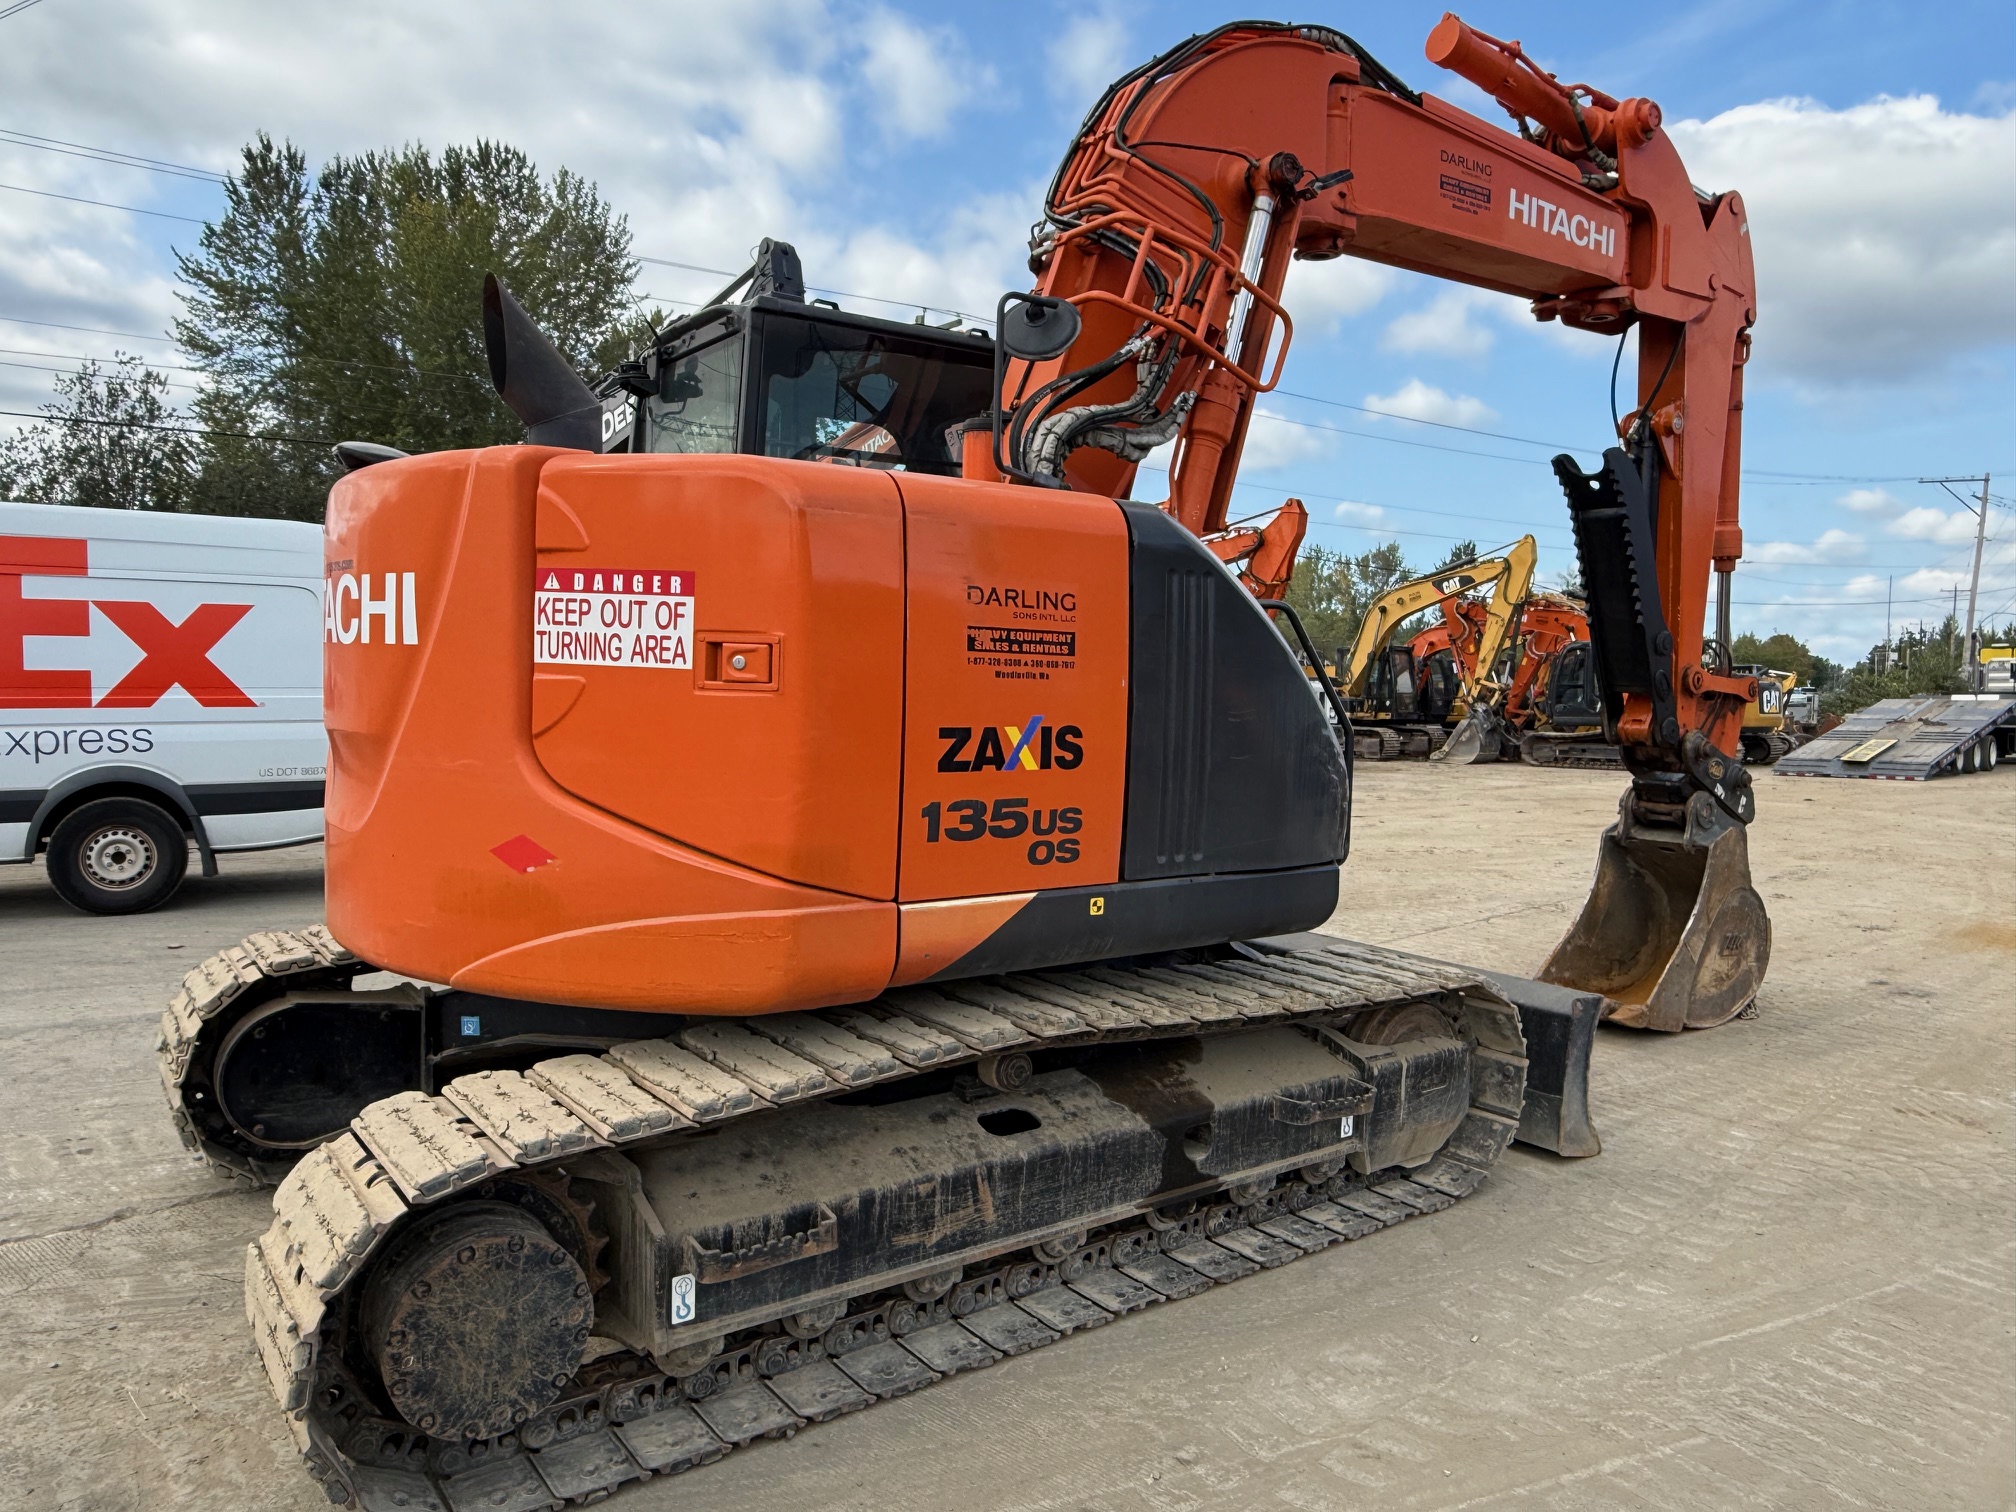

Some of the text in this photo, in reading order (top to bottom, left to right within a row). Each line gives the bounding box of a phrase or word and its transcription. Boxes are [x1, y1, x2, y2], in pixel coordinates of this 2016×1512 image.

[1440, 149, 1492, 177] DARLING
[1508, 187, 1616, 258] HITACHI
[573, 572, 682, 594] DANGER
[1442, 576, 1461, 595] CAT
[323, 571, 419, 646] ACHI
[966, 585, 1077, 612] DARLING
[537, 596, 687, 631] KEEP OUT OF
[1012, 611, 1038, 620] SONS
[1060, 614, 1077, 623] LLC
[536, 630, 687, 665] TURNING AREA
[1009, 631, 1073, 643] EQUIPMENT
[1011, 644, 1020, 652] &
[1022, 643, 1069, 654] RENTALS
[1762, 689, 1781, 713] CAT
[937, 714, 1084, 773] ZAXIS
[258, 767, 274, 777] US
[276, 767, 298, 777] DOT
[1027, 838, 1081, 866] OS
